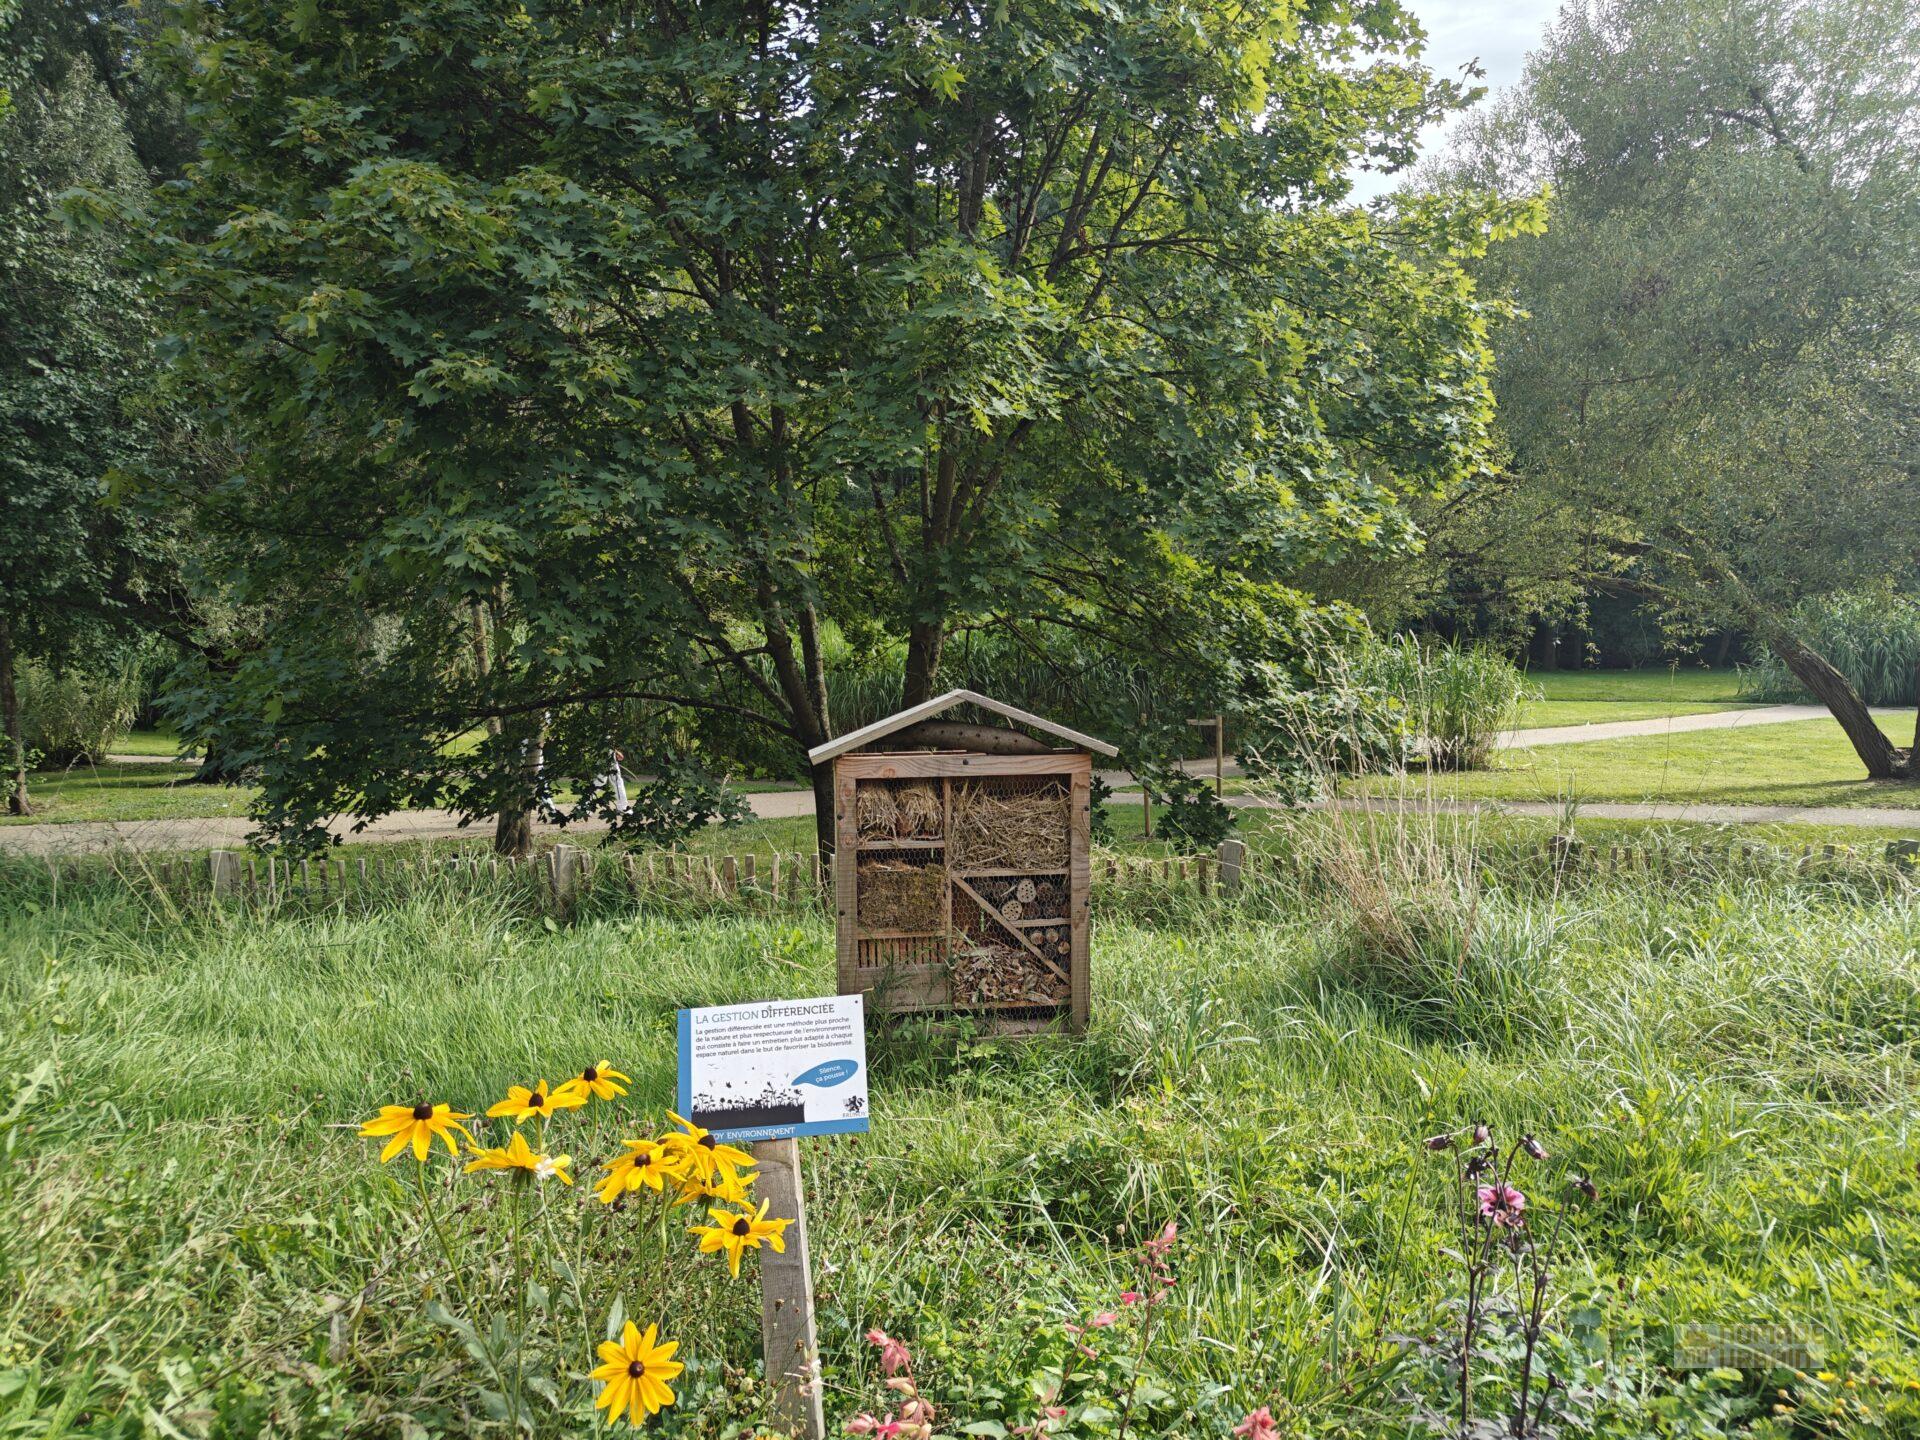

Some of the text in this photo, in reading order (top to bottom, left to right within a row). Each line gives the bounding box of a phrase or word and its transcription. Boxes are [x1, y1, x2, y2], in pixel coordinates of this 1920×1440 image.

[695, 1002, 835, 1024] LA GESTION DIFFÉRENCIÉE
[704, 1027, 727, 1035] gestion
[727, 1024, 762, 1033] différenciée
[786, 1019, 813, 1027] méthode
[814, 1018, 827, 1026] plus
[828, 1016, 850, 1025] proche
[706, 1042, 732, 1050] consiste
[761, 1036, 789, 1045] entretien
[790, 1035, 803, 1043] plus
[803, 1033, 825, 1042] adapté
[830, 1031, 853, 1040] chaque
[711, 1034, 732, 1042] nature
[739, 1033, 753, 1041] plus
[753, 1028, 793, 1039] respectueuse
[695, 1050, 717, 1059] espace
[717, 1048, 740, 1056] naturel
[783, 1041, 809, 1051] favoriser
[823, 1071, 845, 1081] pousse
[727, 1127, 796, 1139] ENVIRONNEMENT
